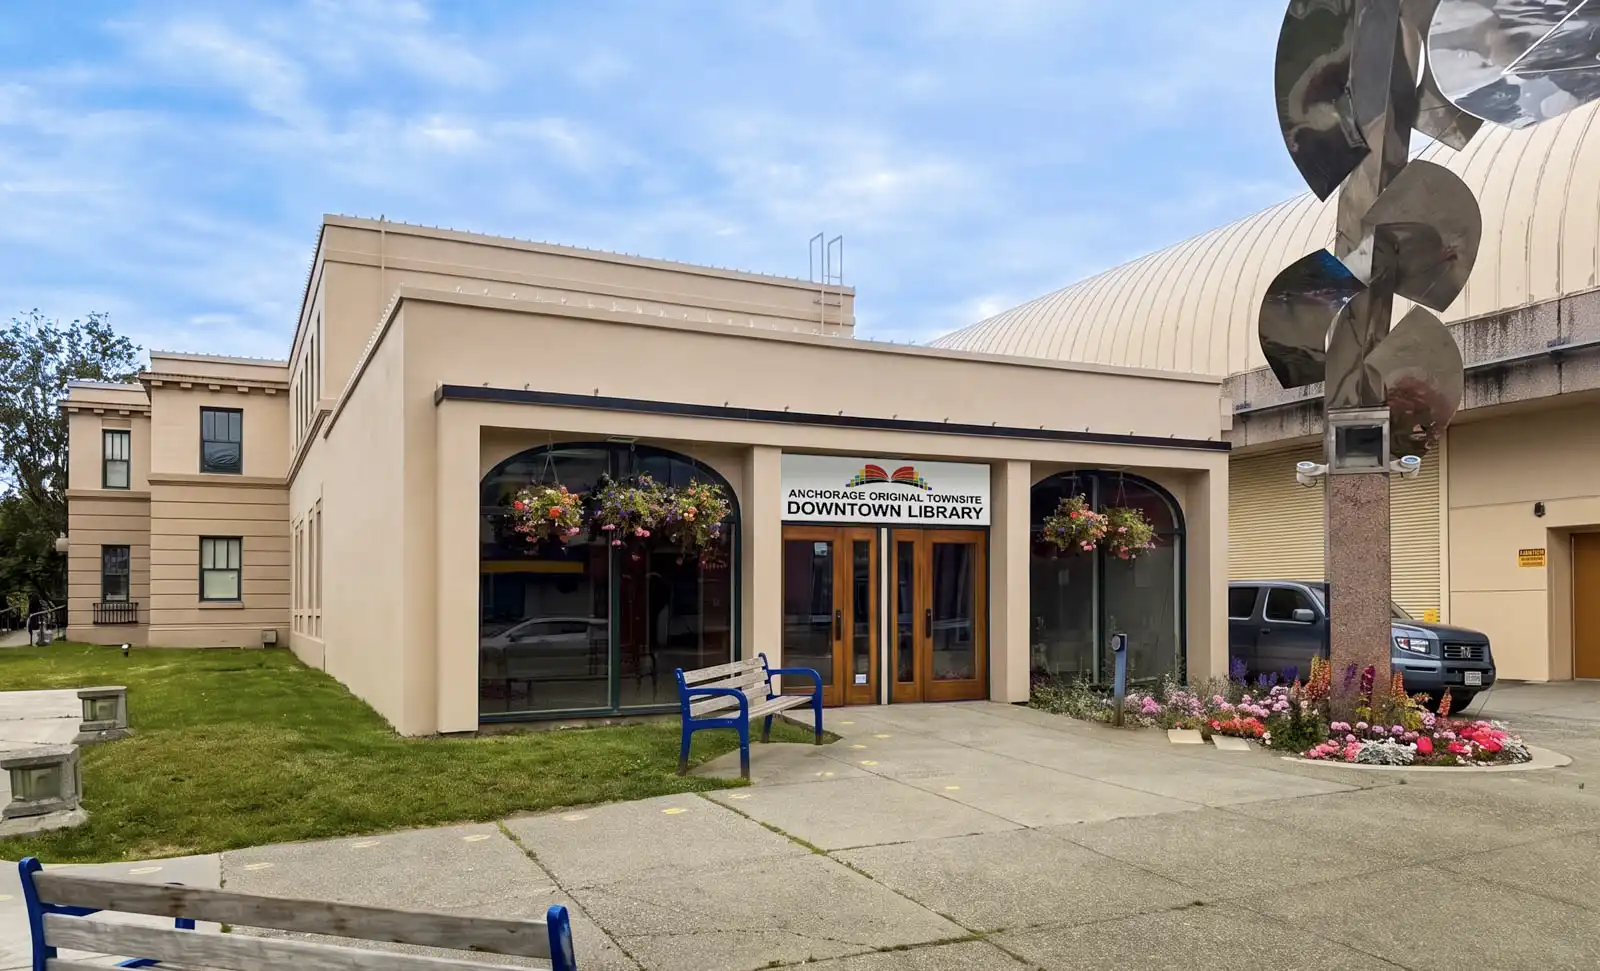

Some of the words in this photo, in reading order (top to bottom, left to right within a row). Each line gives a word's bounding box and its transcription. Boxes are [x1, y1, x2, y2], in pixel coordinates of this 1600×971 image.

[788, 489, 866, 501] ANCHORAGE
[869, 491, 924, 503] ORIGINAL
[926, 494, 982, 505] TOWNSITE
[787, 501, 902, 517] DOWNTOWN
[908, 504, 984, 520] LIBRARY
